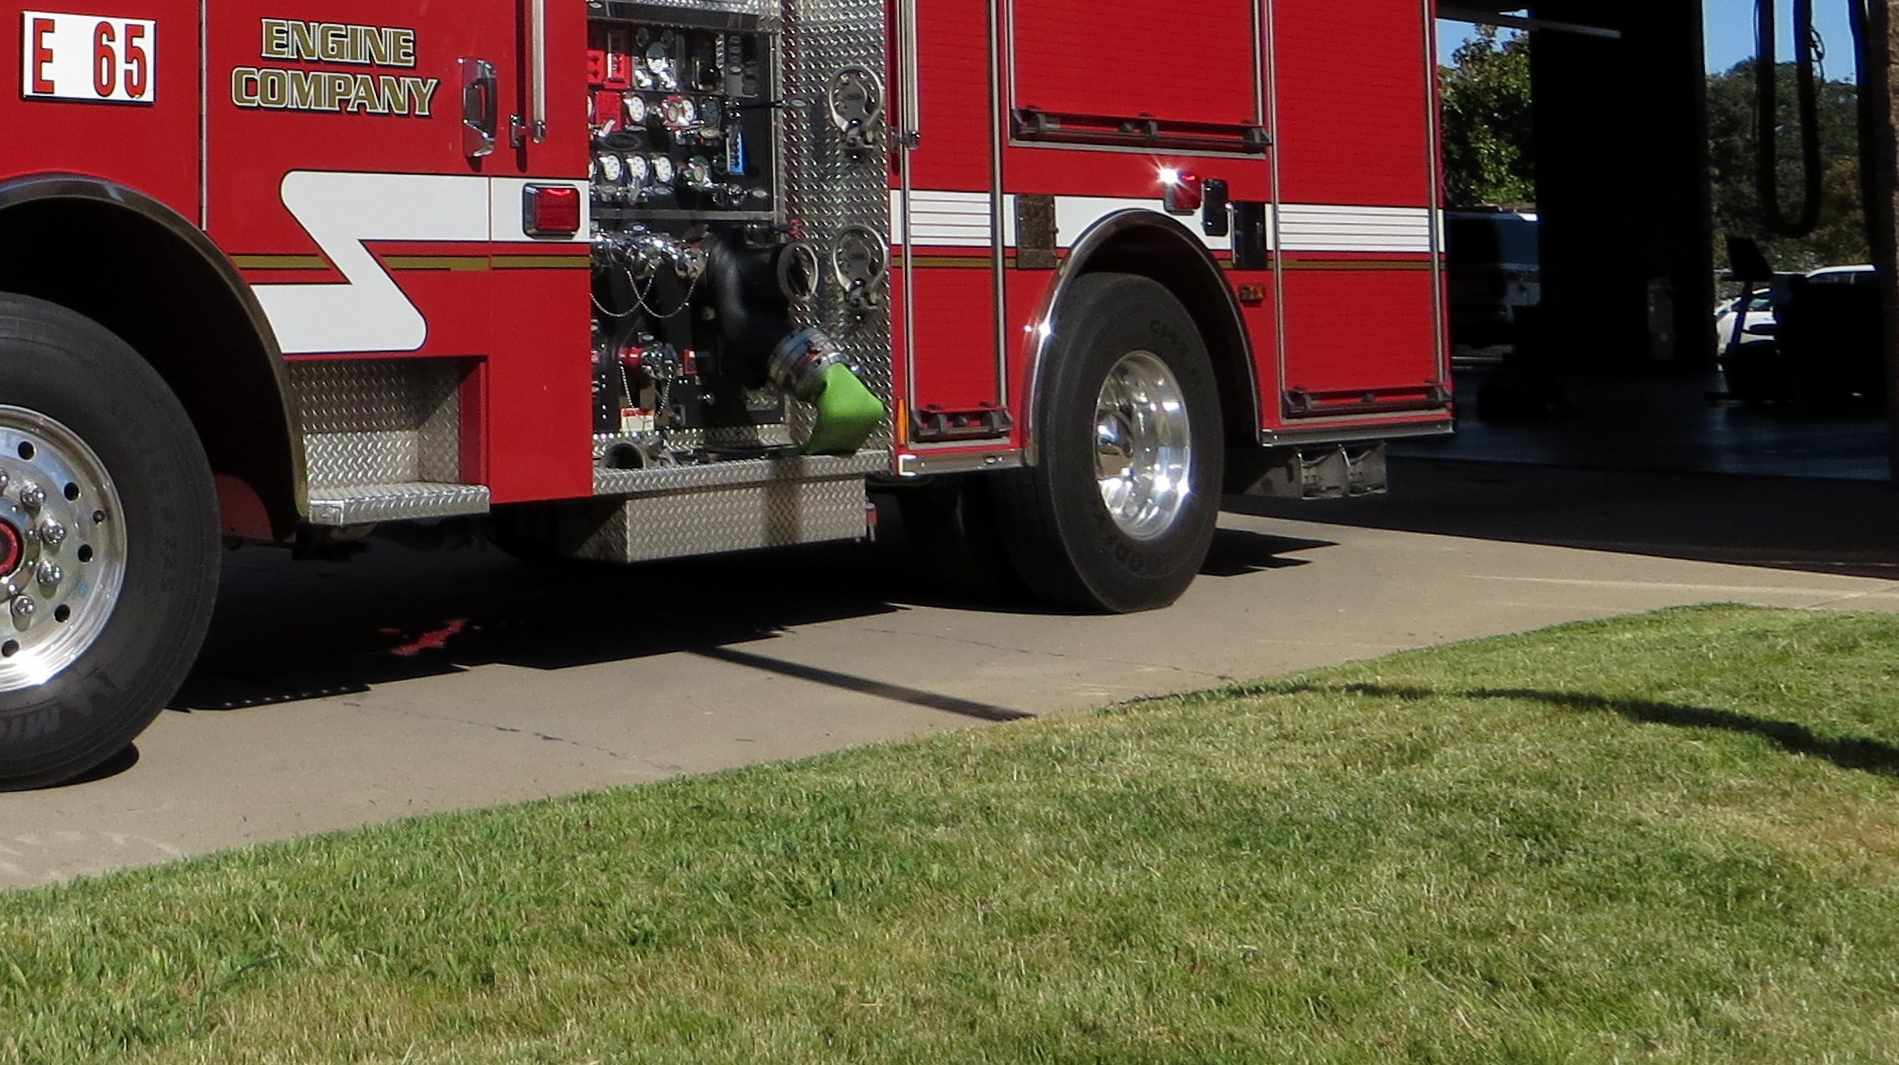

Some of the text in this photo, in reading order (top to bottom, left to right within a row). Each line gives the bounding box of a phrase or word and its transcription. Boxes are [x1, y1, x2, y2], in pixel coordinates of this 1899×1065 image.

[32, 18, 147, 98] E 65
[261, 18, 416, 68] ENGINE
[232, 67, 440, 117] COMPANY
